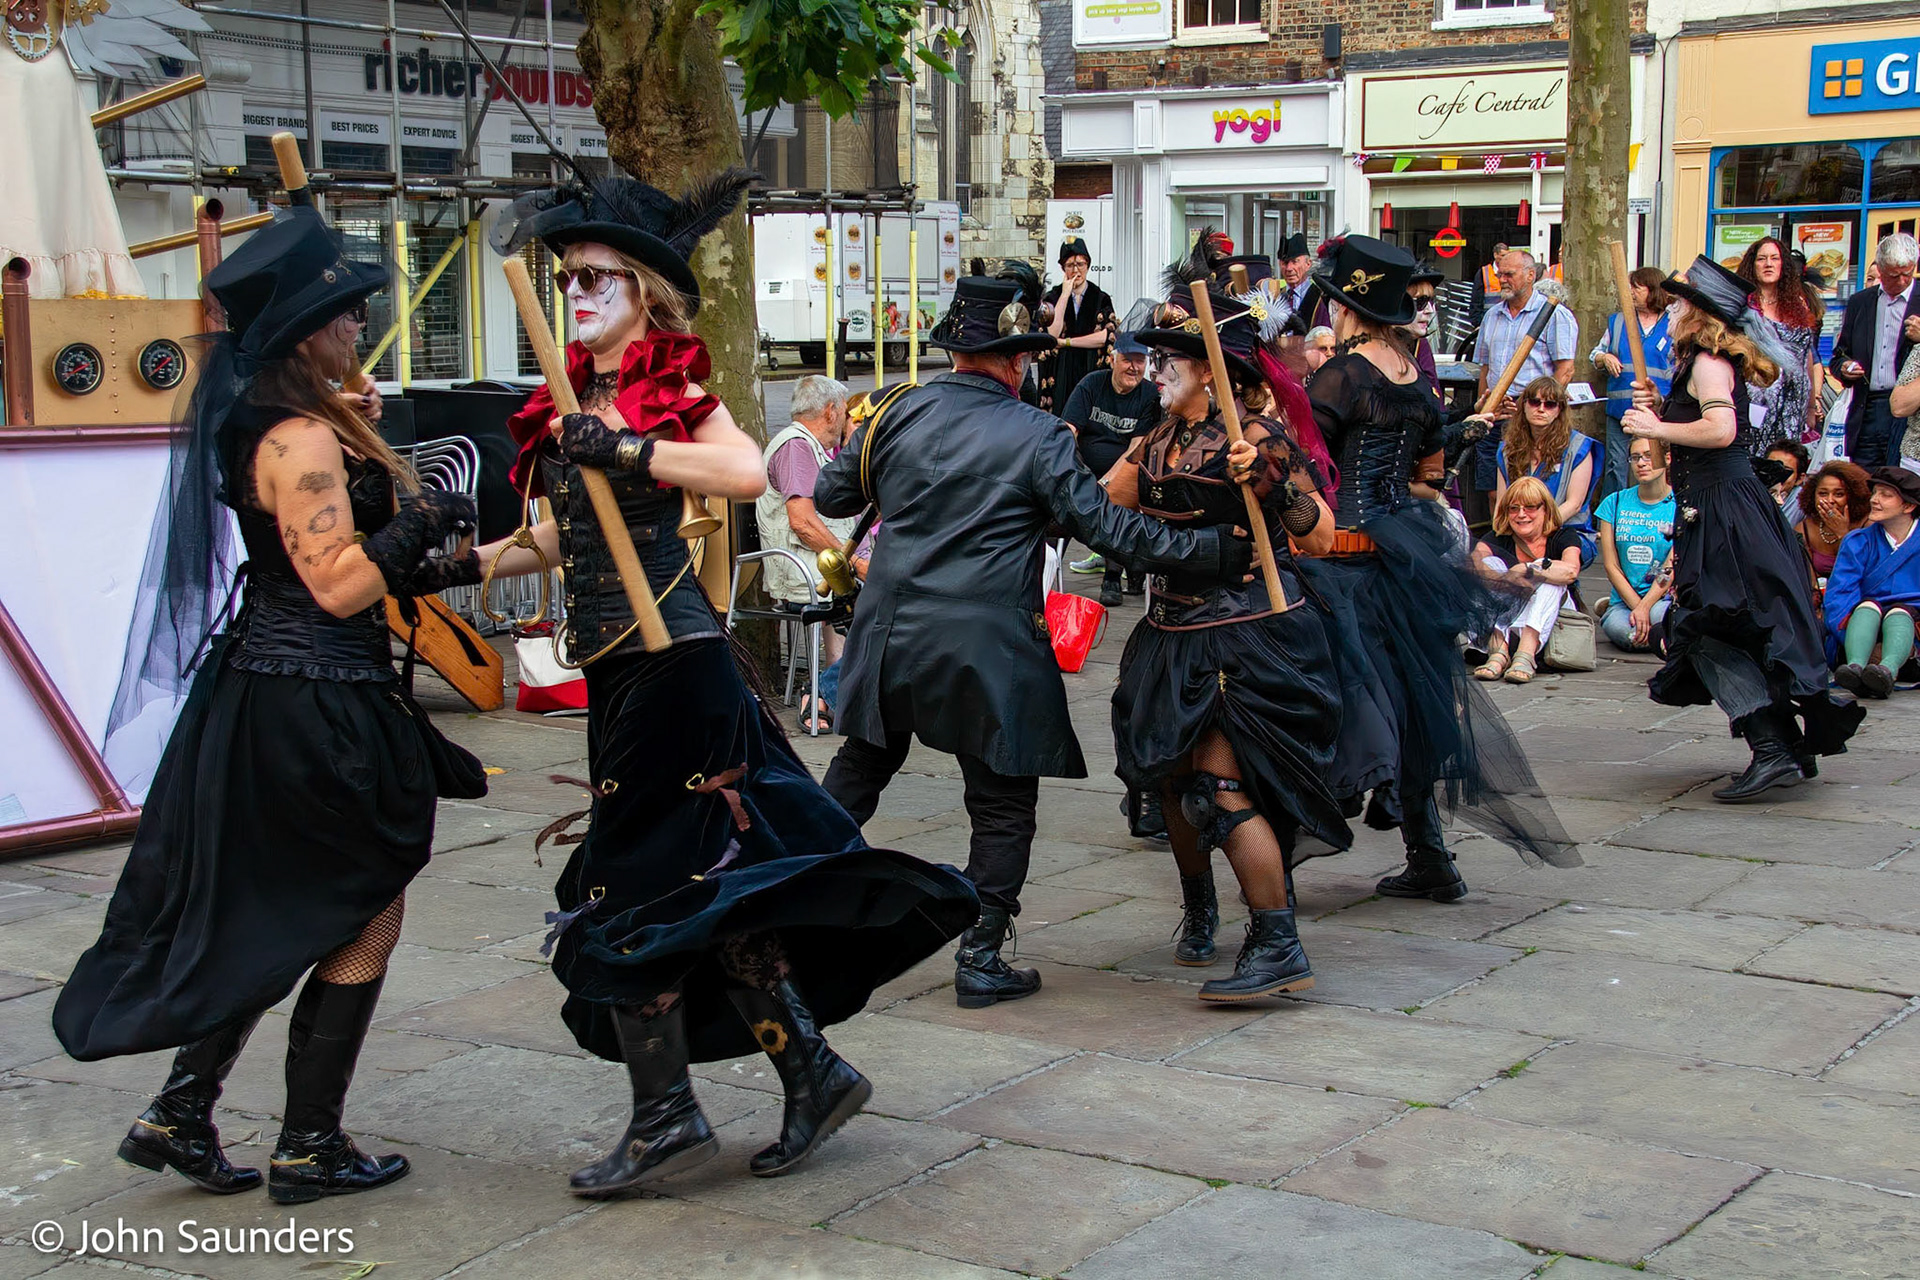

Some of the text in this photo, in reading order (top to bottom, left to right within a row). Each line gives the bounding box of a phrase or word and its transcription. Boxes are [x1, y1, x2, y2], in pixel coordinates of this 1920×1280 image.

[364, 38, 485, 98] richer
[1876, 51, 1920, 96] G
[1417, 78, 1563, 140] Café Central
[243, 114, 308, 129] BIGGEST BRANDS
[331, 121, 379, 134] BEST PRICES
[1212, 98, 1282, 144] yogi
[403, 125, 457, 139] EXPERT ADVICE
[580, 137, 596, 148] BEST
[1620, 509, 1653, 518] science
[1615, 525, 1632, 533] the
